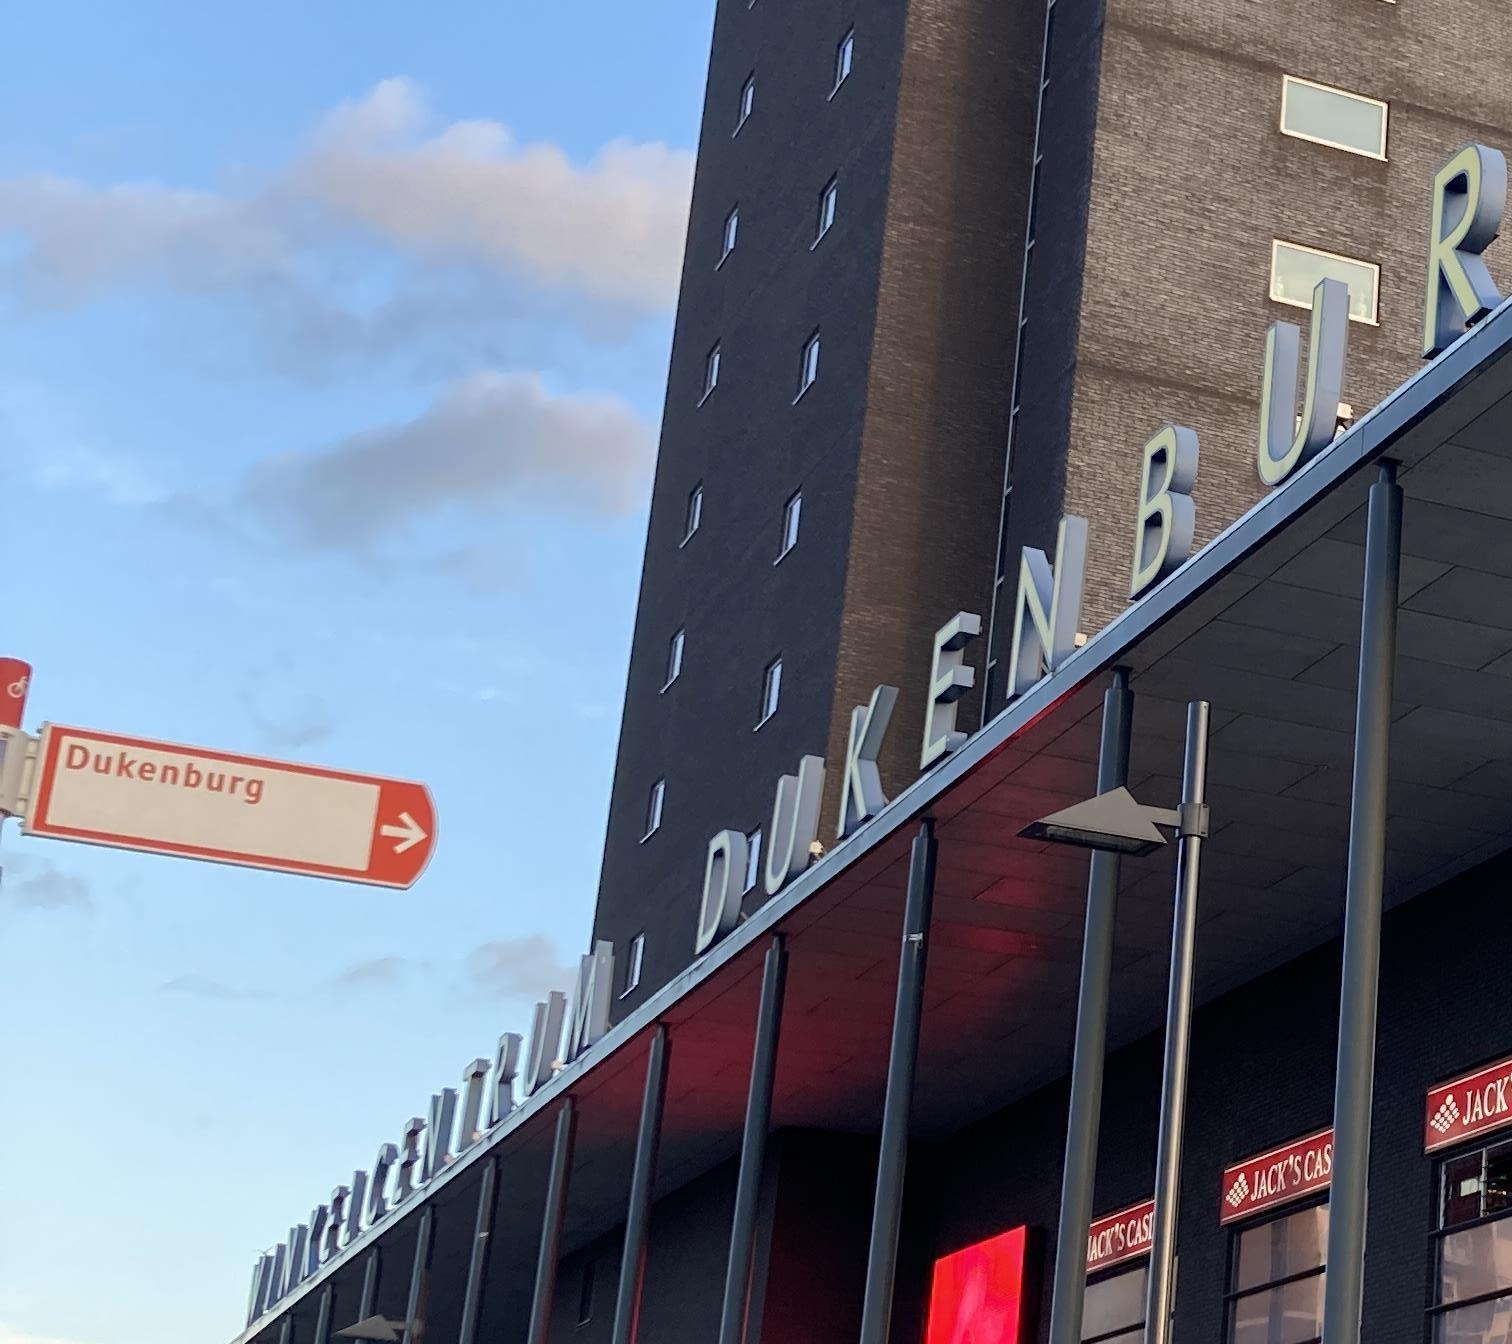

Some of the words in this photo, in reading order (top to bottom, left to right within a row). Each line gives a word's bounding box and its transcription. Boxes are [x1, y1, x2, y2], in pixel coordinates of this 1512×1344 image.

[64, 743, 265, 805] Dukenburg
[1250, 1154, 1302, 1202] JACK'S
[1304, 1144, 1332, 1181] CAS
[1126, 1212, 1154, 1248] CASI
